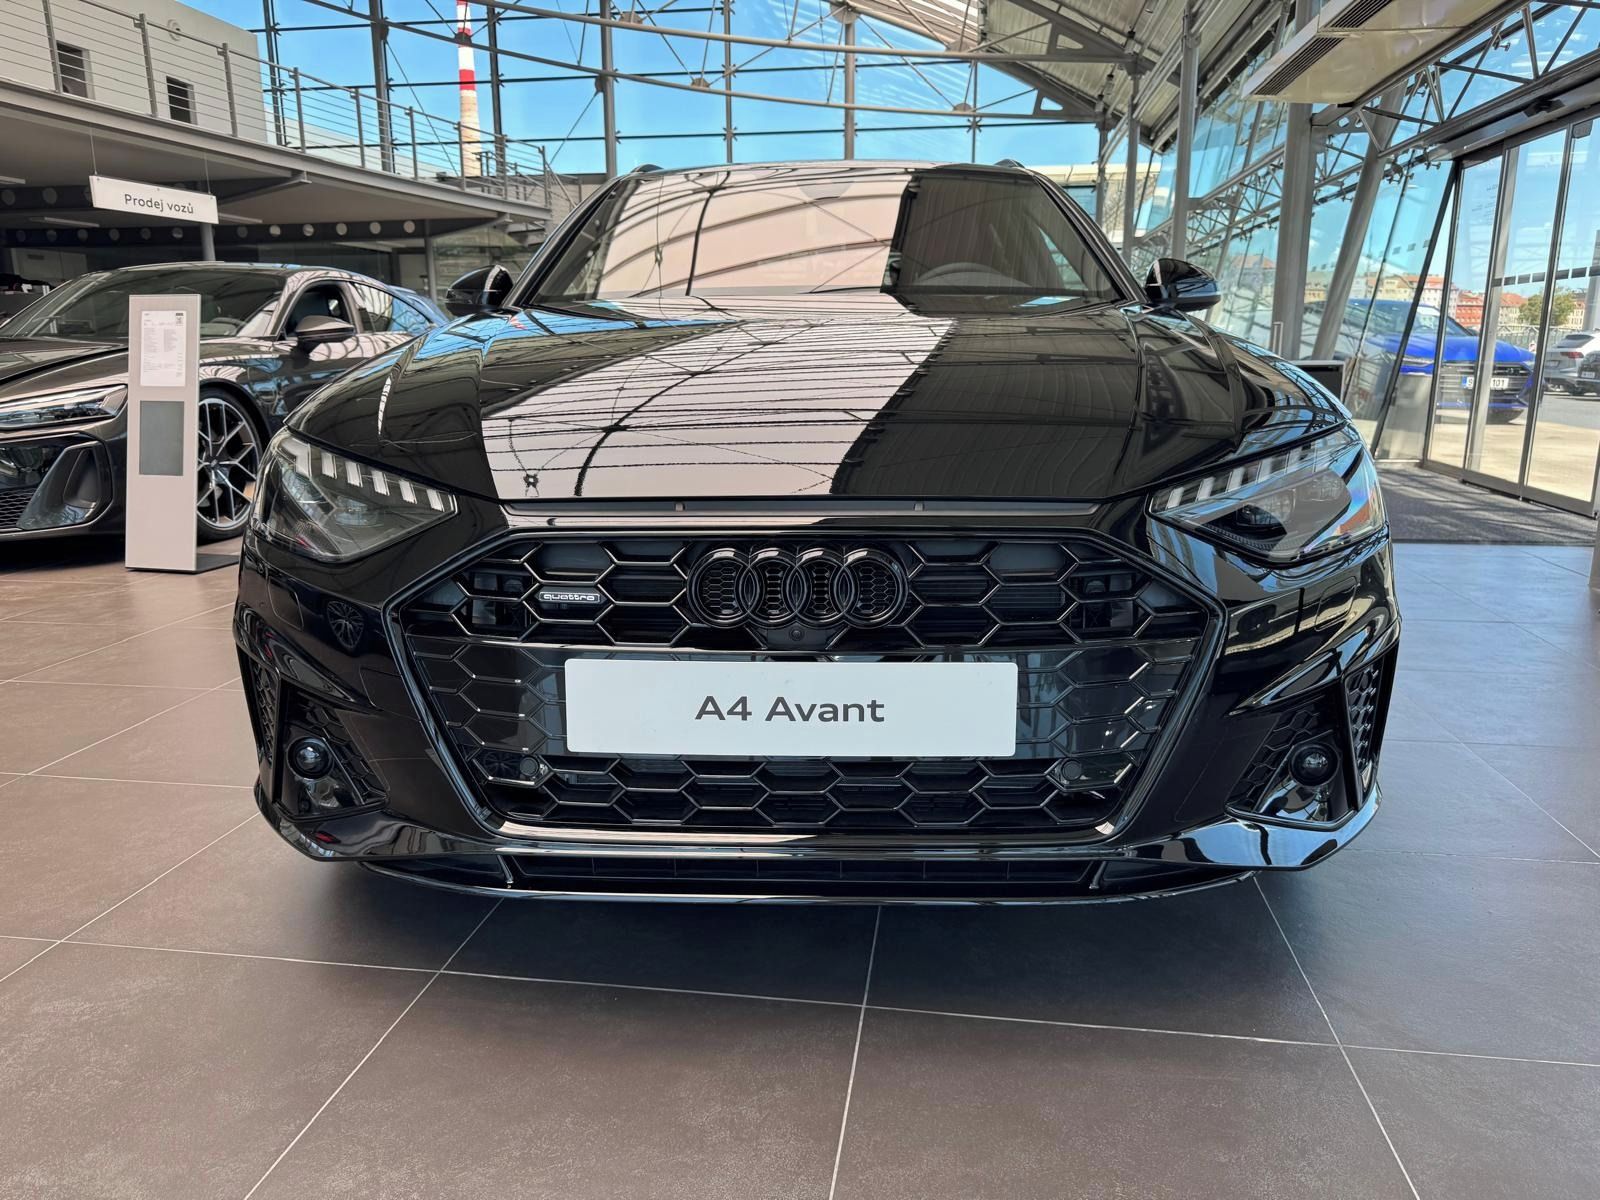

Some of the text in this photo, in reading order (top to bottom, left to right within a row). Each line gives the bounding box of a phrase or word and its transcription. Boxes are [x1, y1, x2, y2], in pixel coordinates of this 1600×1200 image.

[124, 193, 194, 214] Prodej vozů
[694, 695, 885, 722] A4 Avant
